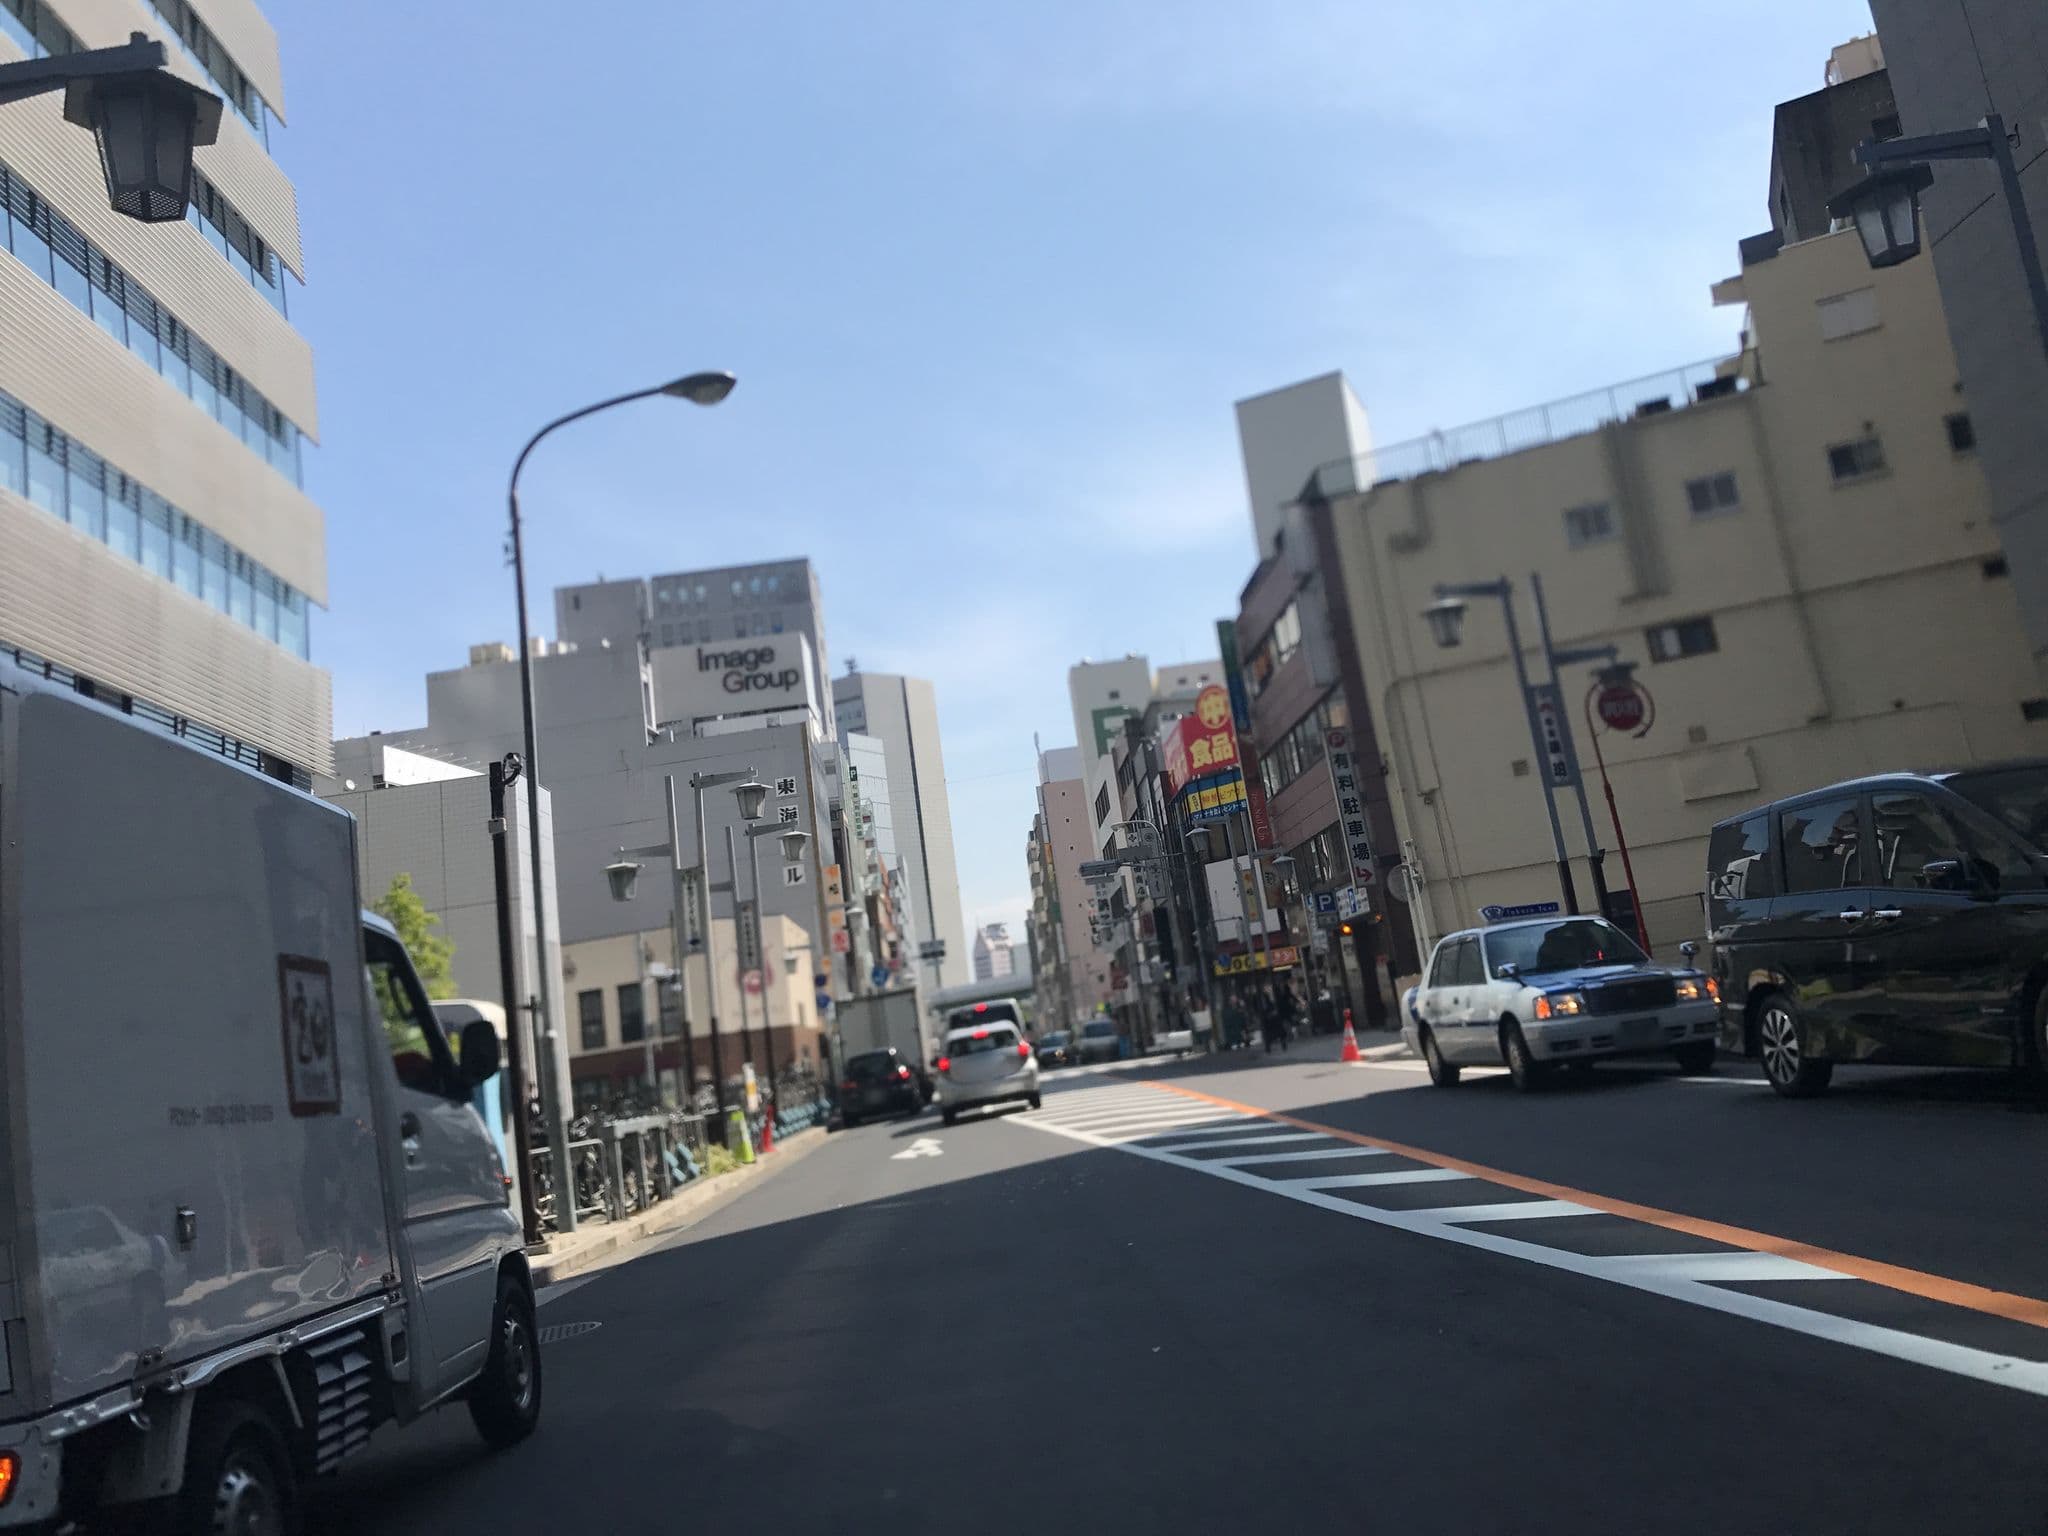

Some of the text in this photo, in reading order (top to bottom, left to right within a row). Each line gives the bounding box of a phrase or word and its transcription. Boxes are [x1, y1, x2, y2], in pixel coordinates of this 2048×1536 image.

[696, 646, 776, 673] Image
[723, 668, 800, 694] Group
[1333, 753, 1371, 861] 有料駐車場
[1318, 894, 1331, 911] P
